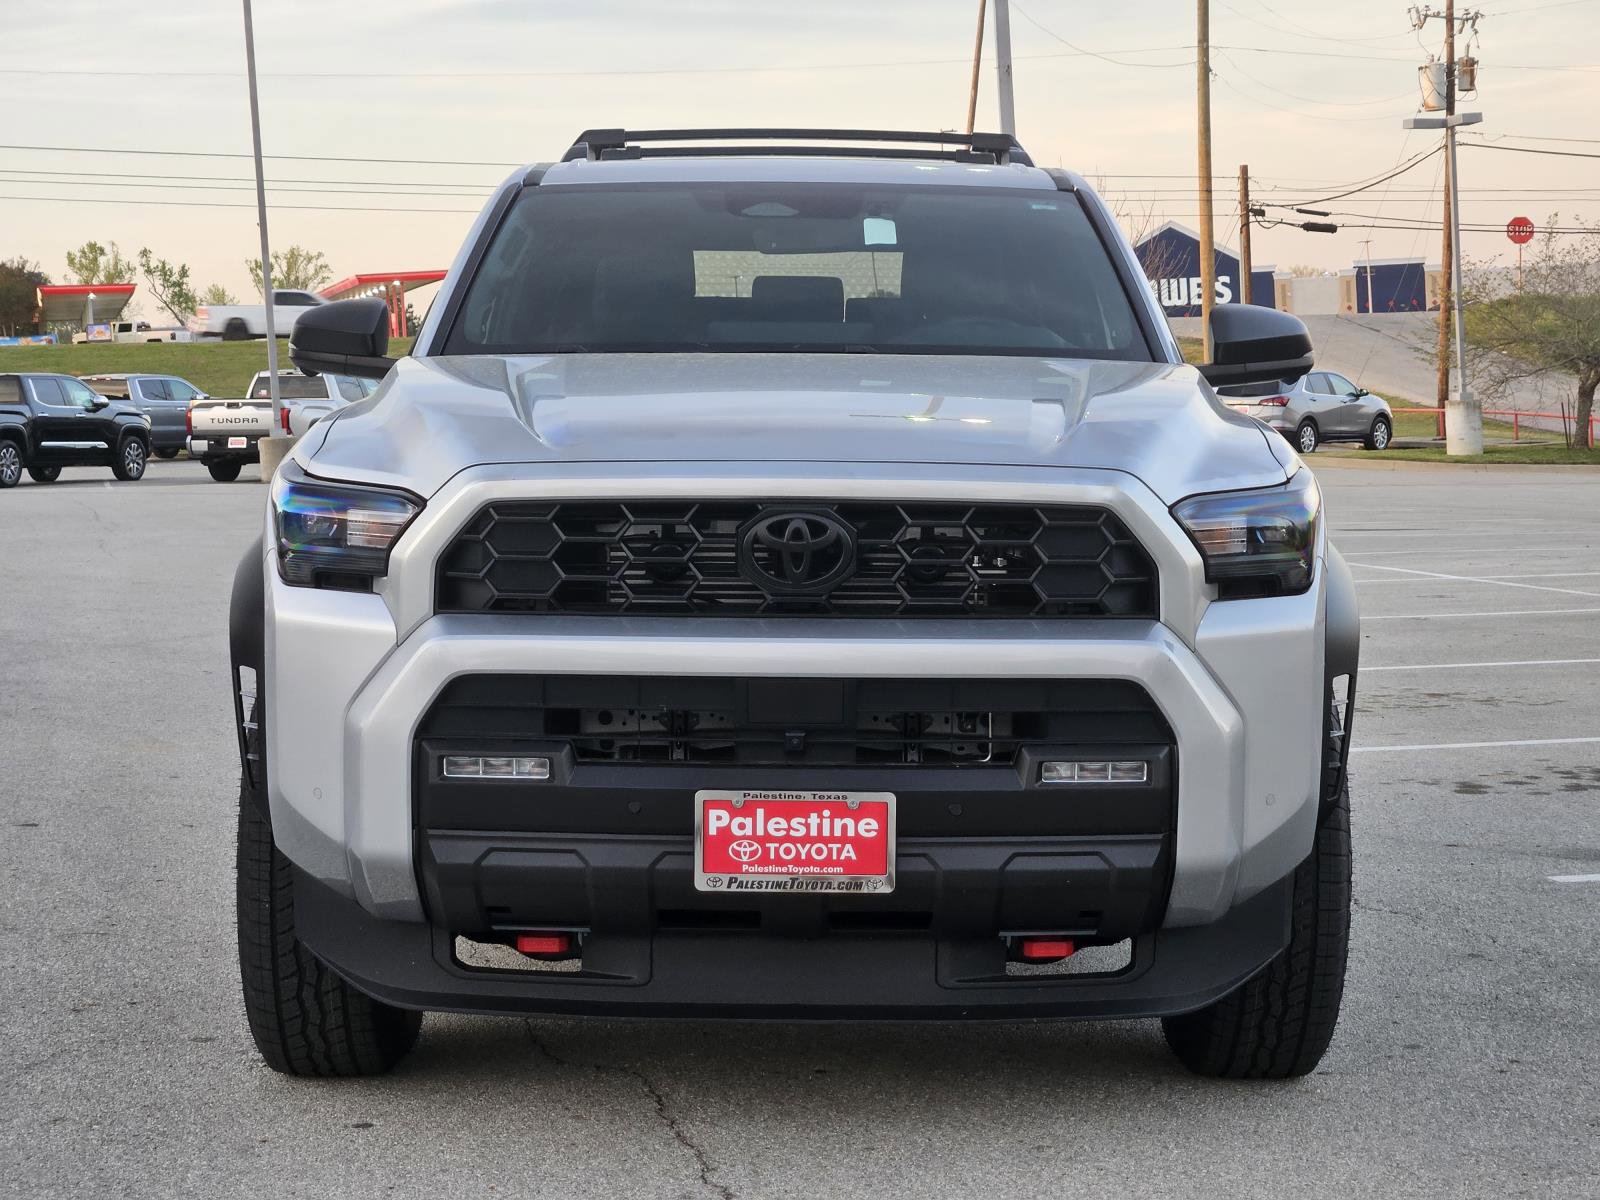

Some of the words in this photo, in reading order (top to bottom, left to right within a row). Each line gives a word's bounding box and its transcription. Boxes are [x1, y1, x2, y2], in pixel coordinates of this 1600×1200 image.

[1508, 224, 1533, 236] STOP
[743, 792, 806, 800] Palestine,
[708, 808, 879, 837] Palestine
[765, 843, 857, 860] TOYOTA
[742, 864, 844, 874] PalestineToyota.com
